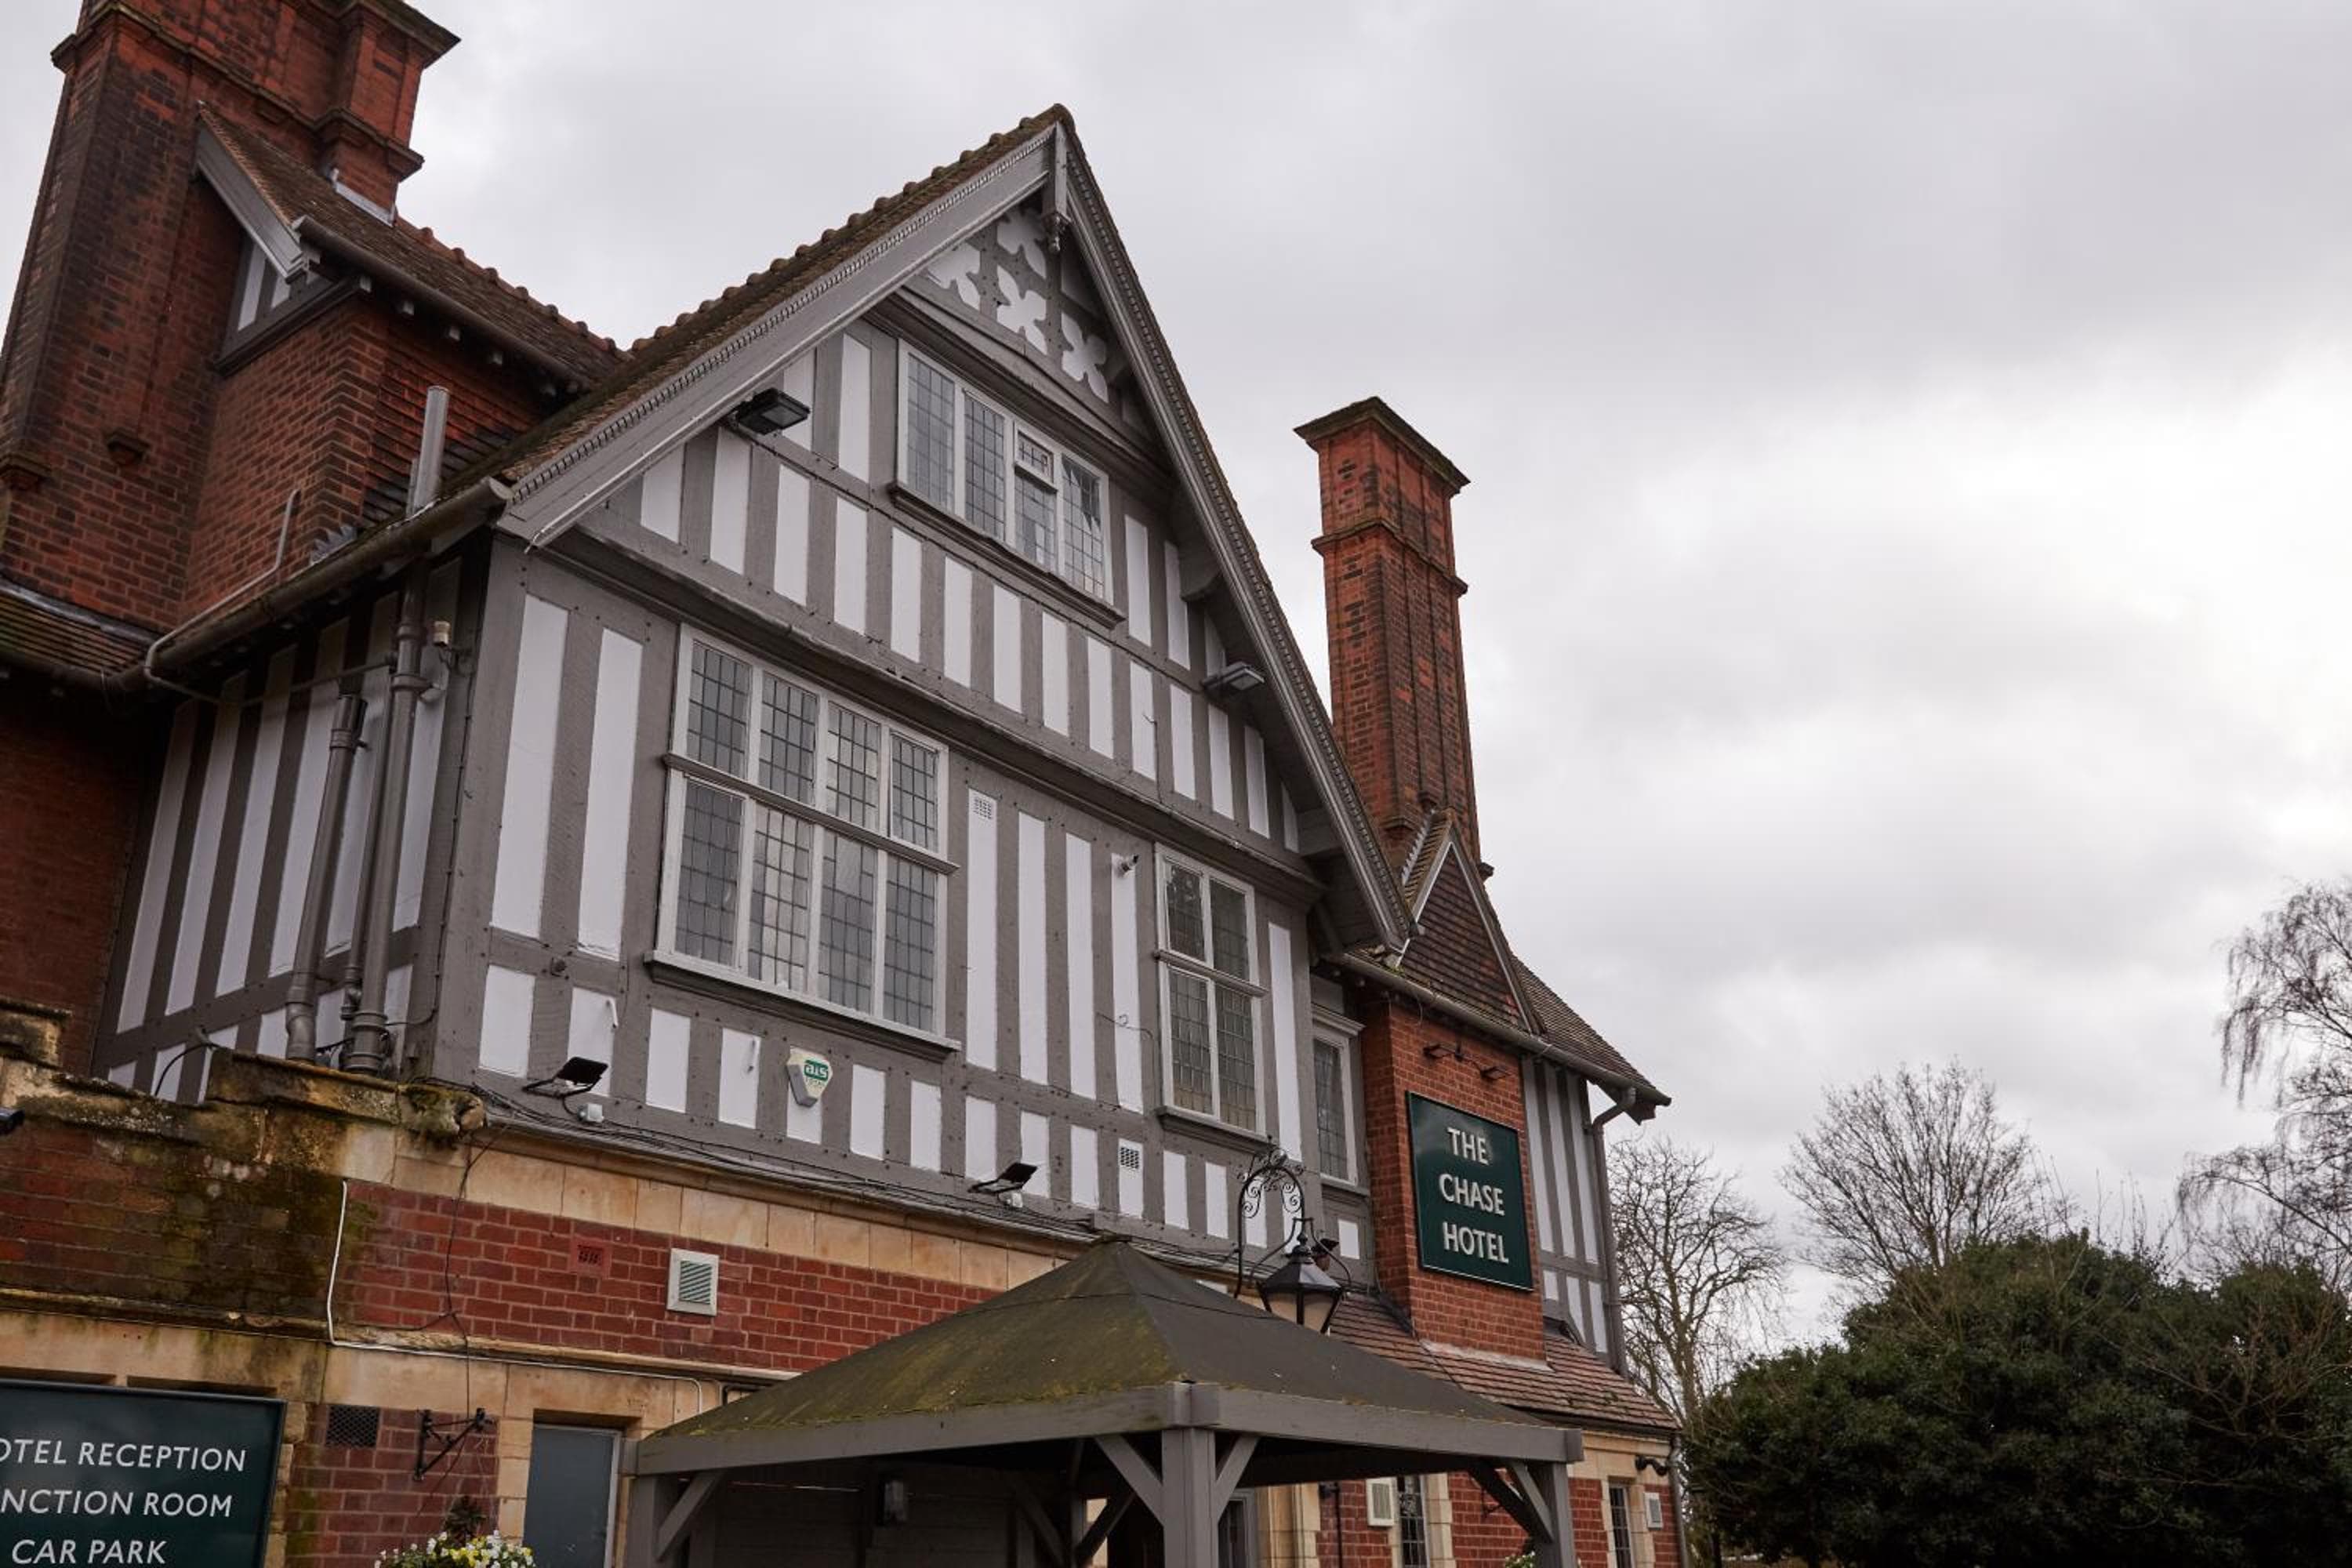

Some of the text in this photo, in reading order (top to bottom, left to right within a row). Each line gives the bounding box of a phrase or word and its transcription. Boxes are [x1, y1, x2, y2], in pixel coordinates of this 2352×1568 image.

[1447, 1127, 1488, 1165] THE
[1439, 1173, 1504, 1216] CHASE
[1443, 1221, 1509, 1264] HOTEL
[78, 1442, 246, 1472] RECEPTION
[143, 1492, 232, 1517] ROOM
[12, 1539, 166, 1564] CAR PARK
